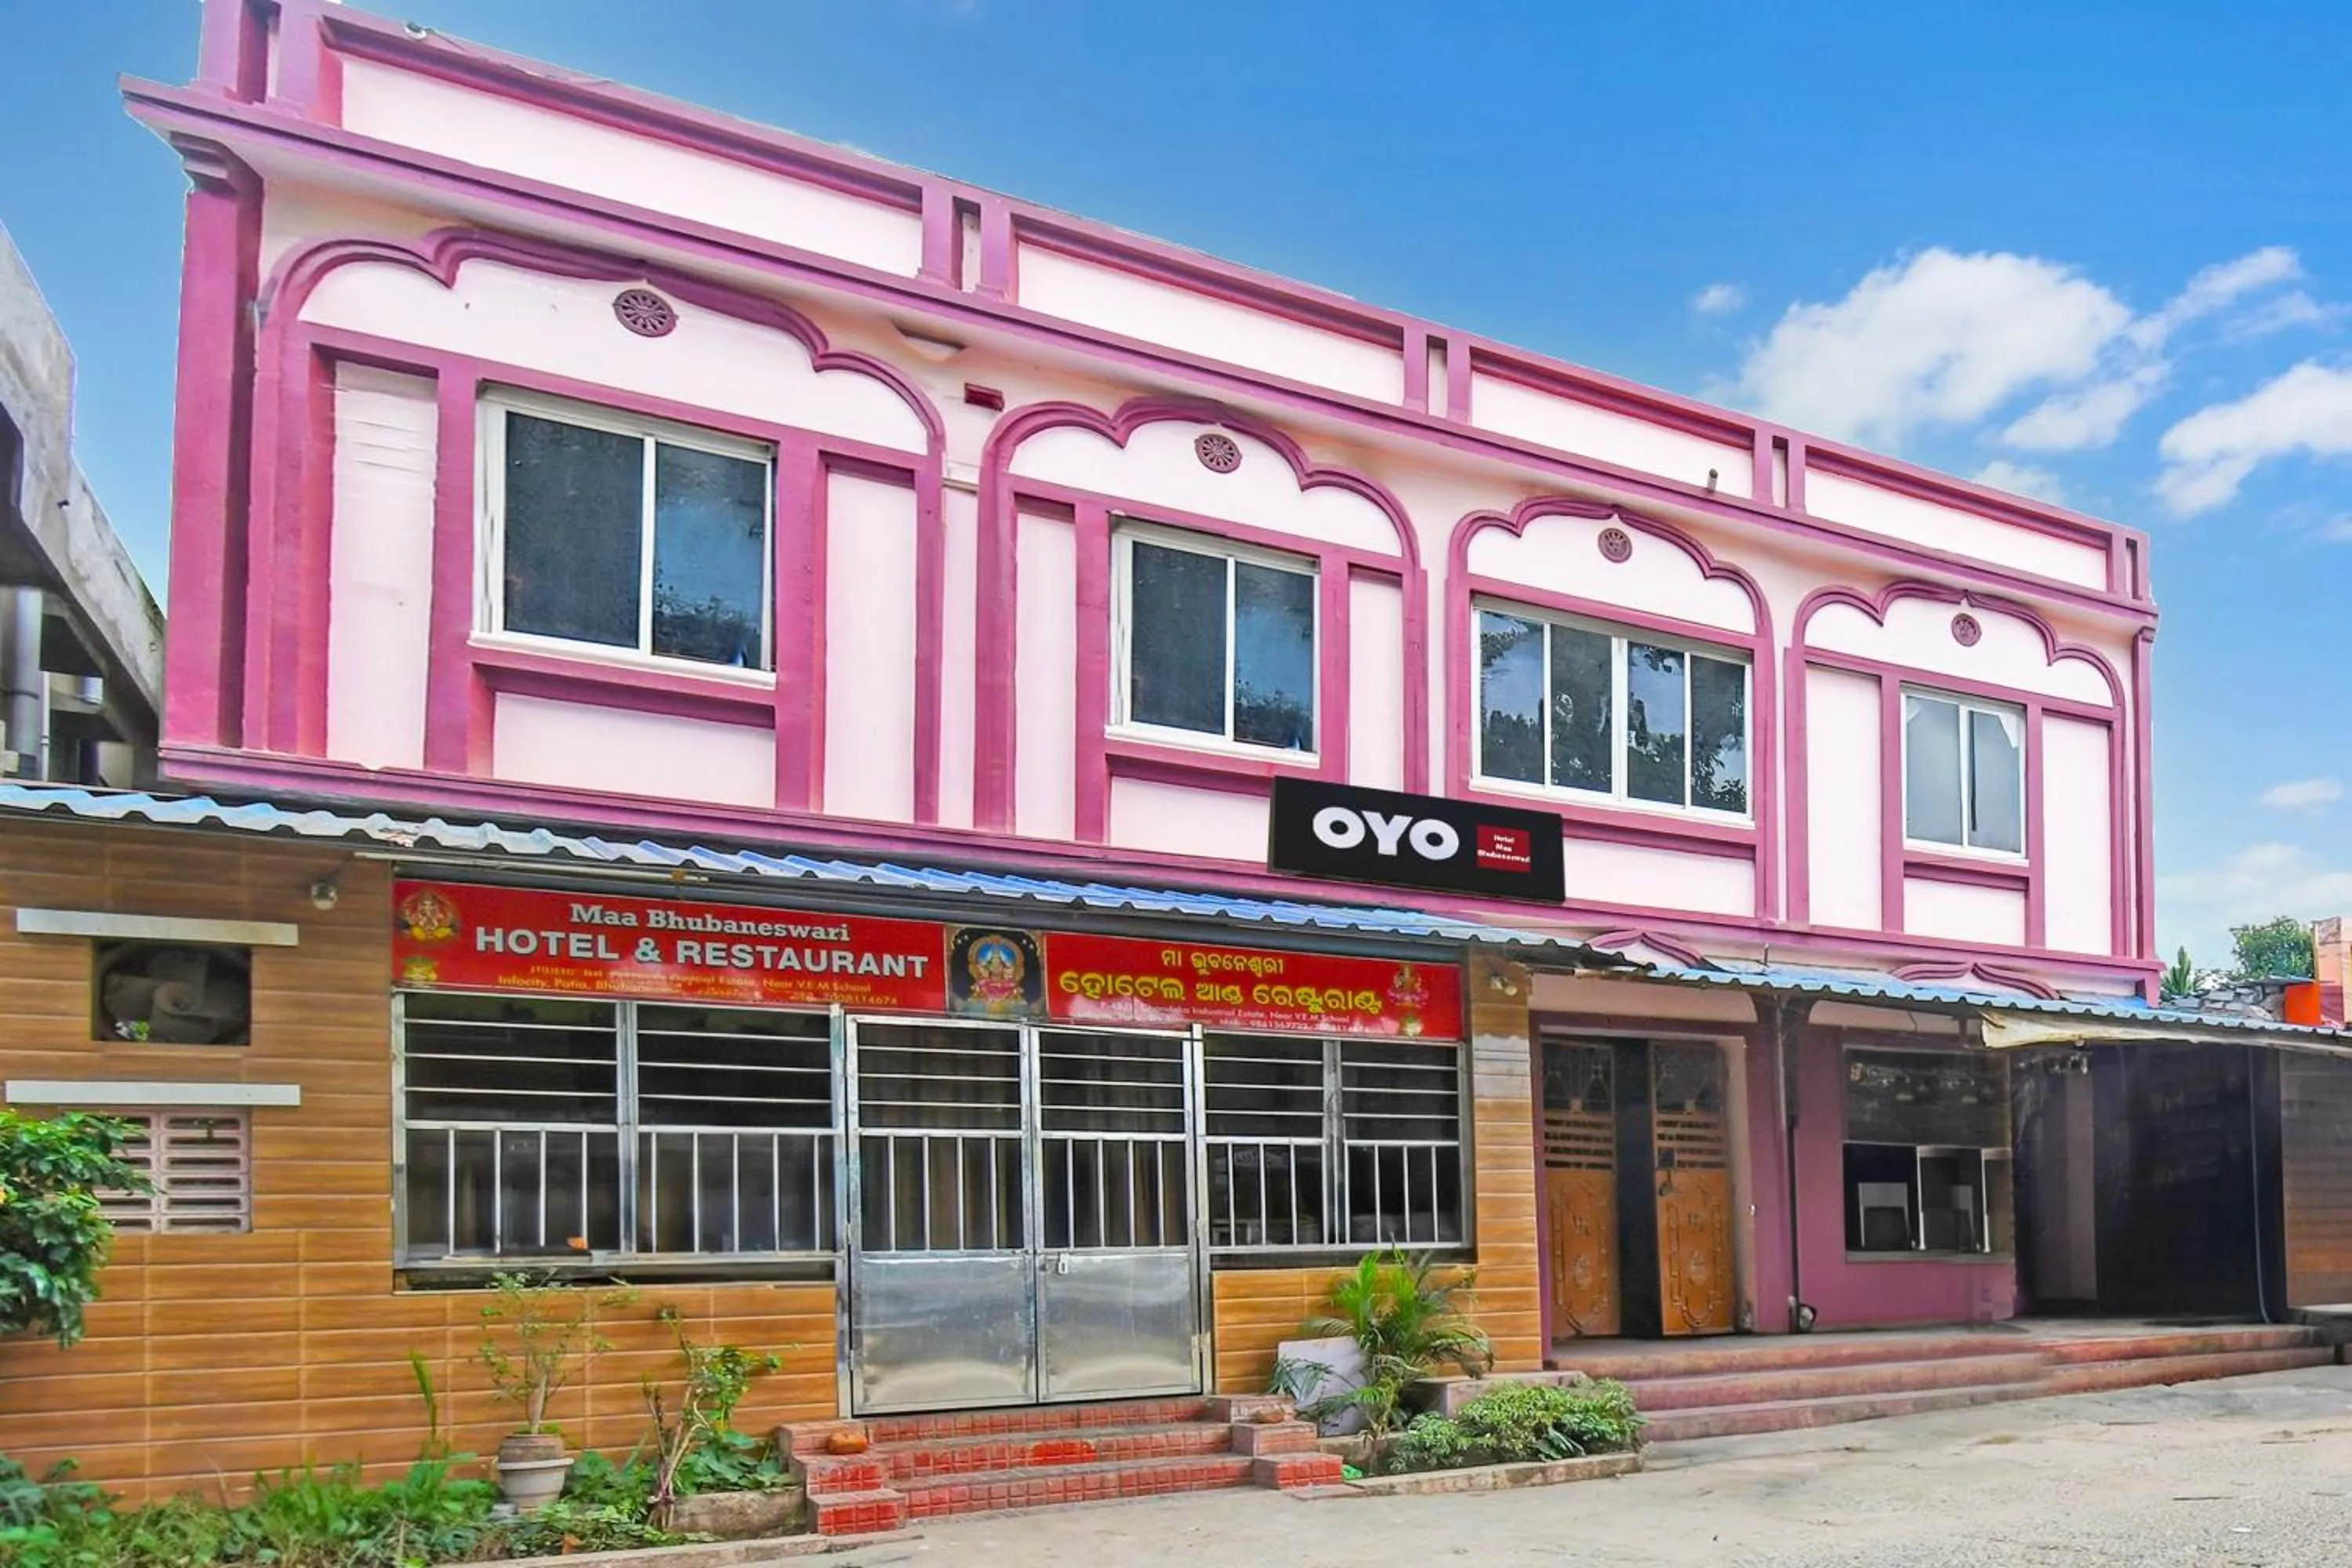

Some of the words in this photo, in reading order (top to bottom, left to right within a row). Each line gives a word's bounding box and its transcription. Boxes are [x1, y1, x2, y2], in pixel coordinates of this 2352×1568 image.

[1312, 807, 1460, 860] OYO
[570, 903, 638, 927] Maa
[647, 909, 851, 941] Bhubaneswari
[476, 927, 619, 960] HOTEL
[634, 938, 660, 964] &
[677, 940, 928, 978] RESTAURANT
[1161, 949, 1182, 967] ମା
[1059, 971, 1186, 1001] ହୋଟେଲ
